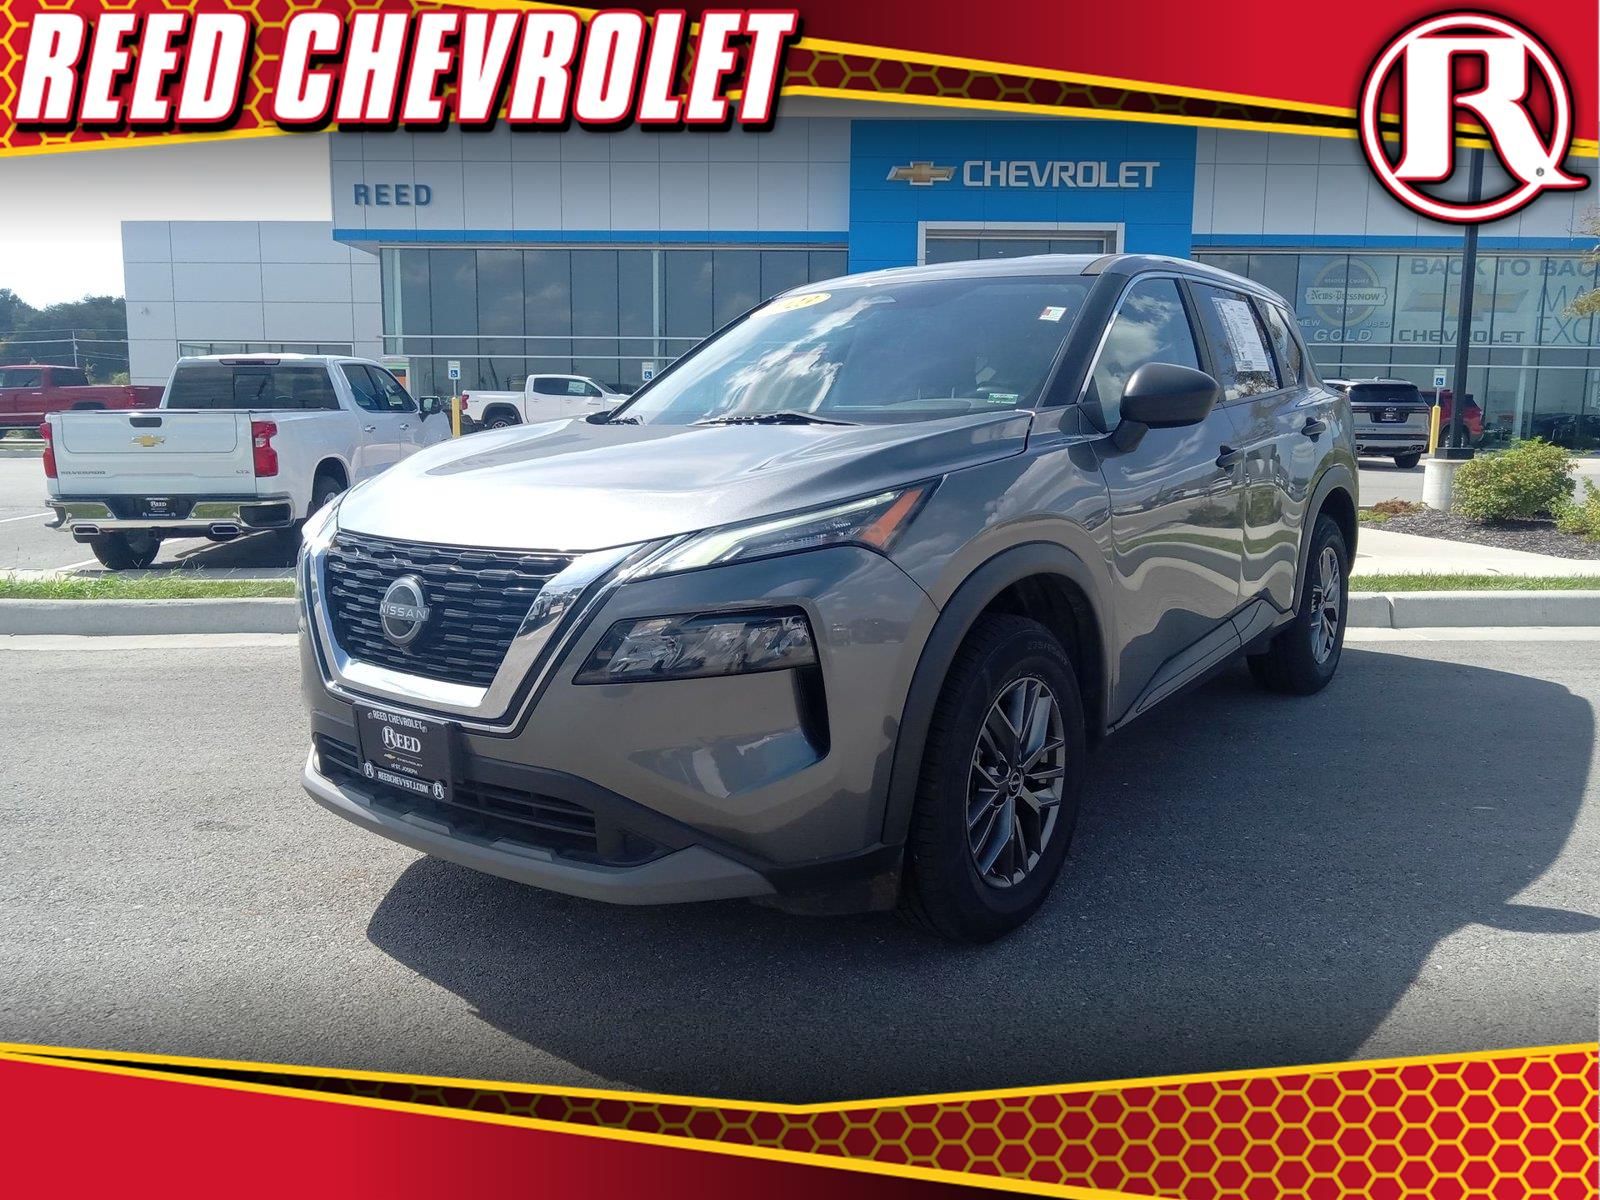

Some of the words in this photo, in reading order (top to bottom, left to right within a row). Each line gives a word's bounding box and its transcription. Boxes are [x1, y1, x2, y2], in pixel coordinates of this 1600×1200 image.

[963, 160, 1160, 188] CHEVROLET
[353, 183, 432, 206] REED
[1410, 257, 1487, 275] BACK
[1497, 258, 1531, 276] TO
[1539, 259, 1600, 277] BAC
[1313, 329, 1373, 342] GOLD
[1399, 329, 1525, 344] CHEVOLET
[1535, 316, 1600, 344] EXC
[380, 603, 426, 620] NISSAN
[372, 709, 387, 721] REED
[388, 714, 422, 729] CHEVROLET
